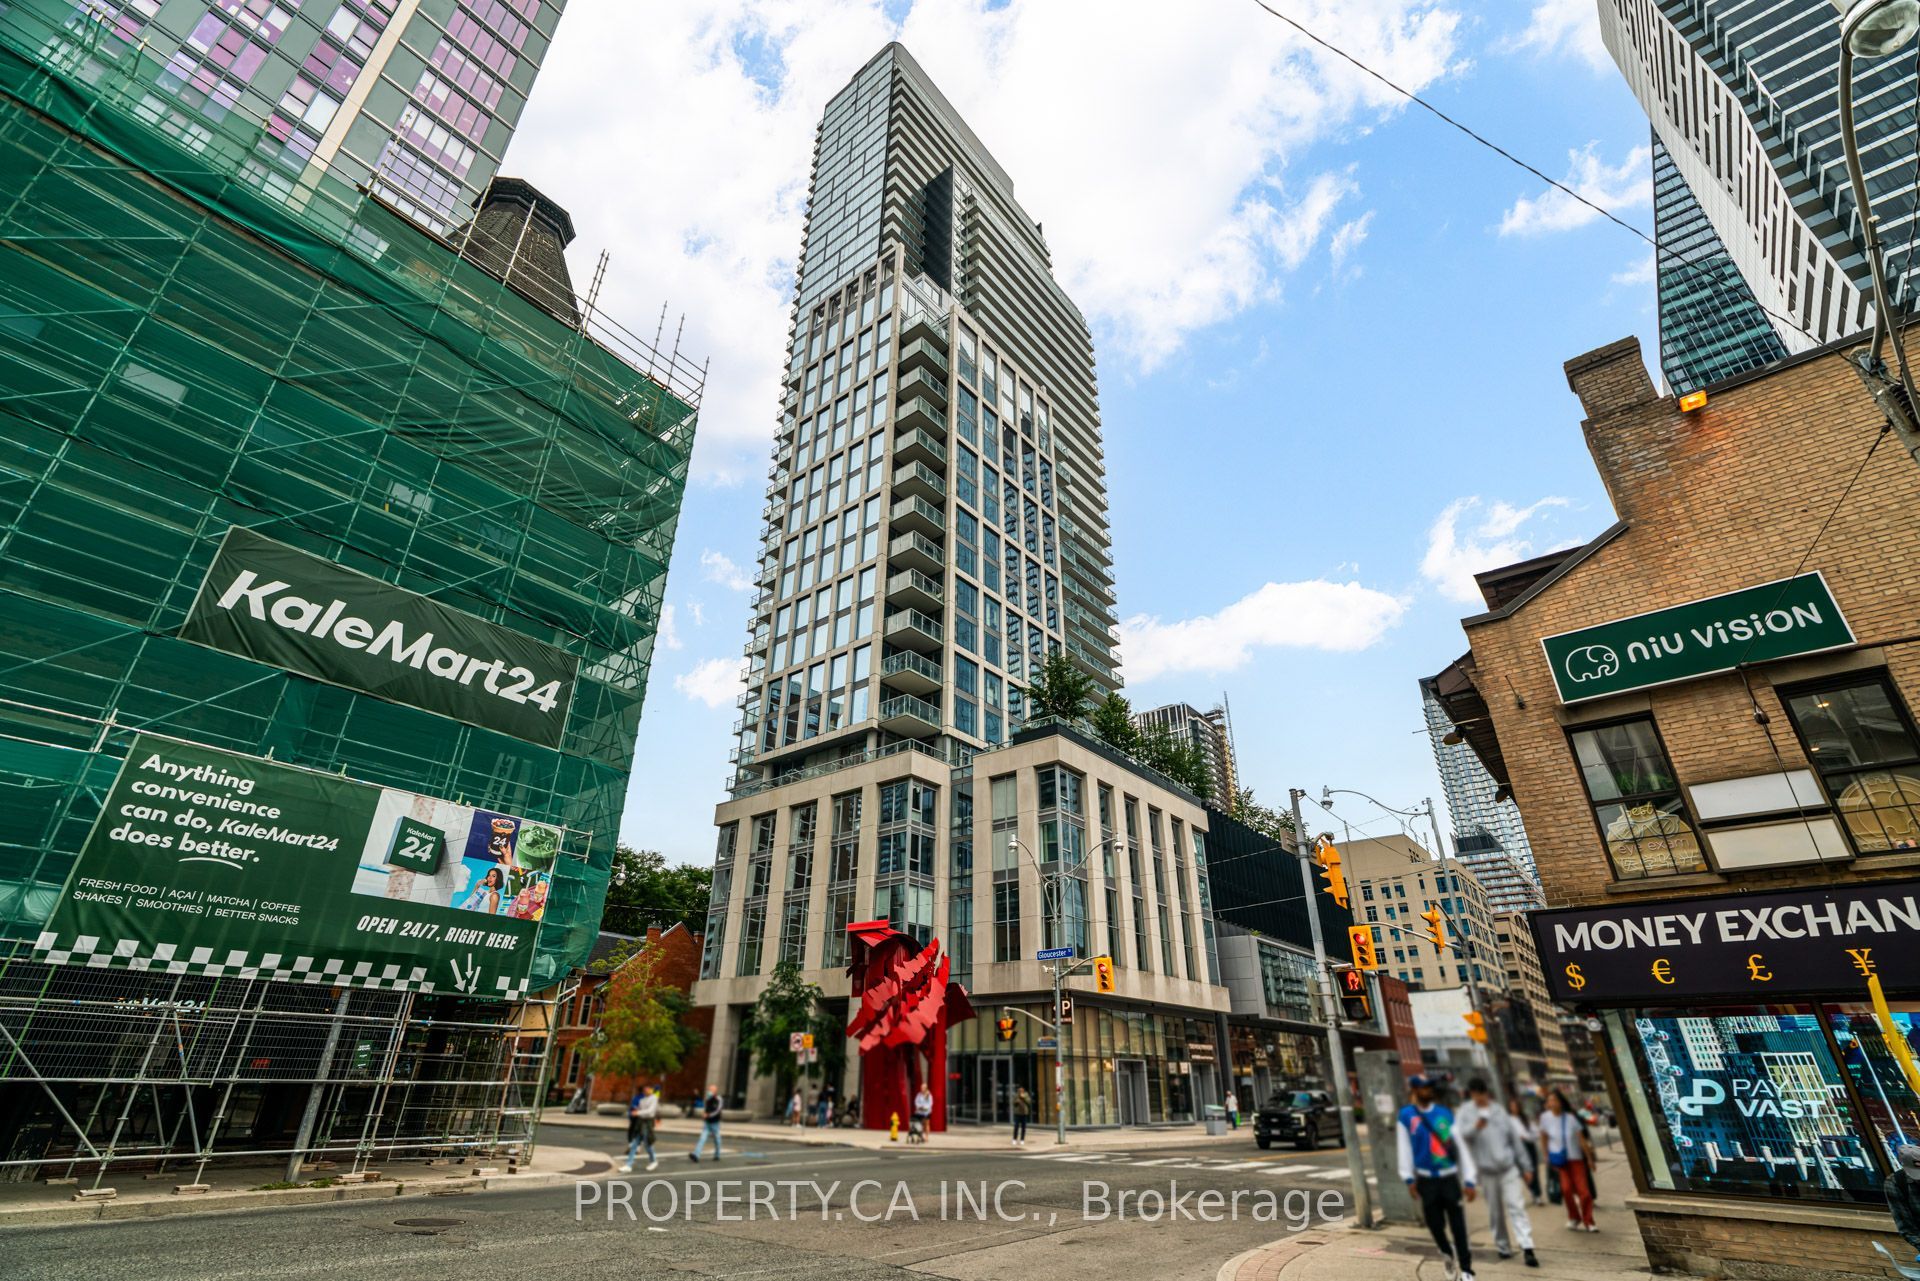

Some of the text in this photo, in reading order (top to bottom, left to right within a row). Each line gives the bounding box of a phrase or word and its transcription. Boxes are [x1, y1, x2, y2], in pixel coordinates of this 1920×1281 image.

[216, 569, 563, 713] KaleMart24
[139, 753, 256, 795] Anything
[131, 780, 281, 819] convenience
[109, 822, 260, 863] does better.
[120, 803, 340, 852] can do, KaleMart24
[406, 827, 437, 843] KaleMart
[492, 836, 507, 846] 24
[1647, 838, 1689, 851] exam
[398, 836, 435, 862] 24
[72, 890, 123, 905] SHAKES
[135, 898, 204, 914] SMOOTHIES
[214, 908, 256, 921] BETTER
[257, 912, 299, 926] SNACKS
[78, 877, 122, 891] FRESH
[123, 883, 158, 895] FOOD
[168, 889, 196, 901] AÇAÍ
[206, 894, 251, 907] MATCHA
[260, 901, 302, 914] COFFEE
[356, 915, 519, 950] OPEN 24/7, RIGHT HERE
[1554, 896, 1920, 953] MONEY EXCHAN
[1037, 950, 1067, 960] Gloucester
[1061, 1000, 1071, 1016] P
[1732, 1078, 1789, 1098] PAY
[1733, 1099, 1827, 1119] VAST
